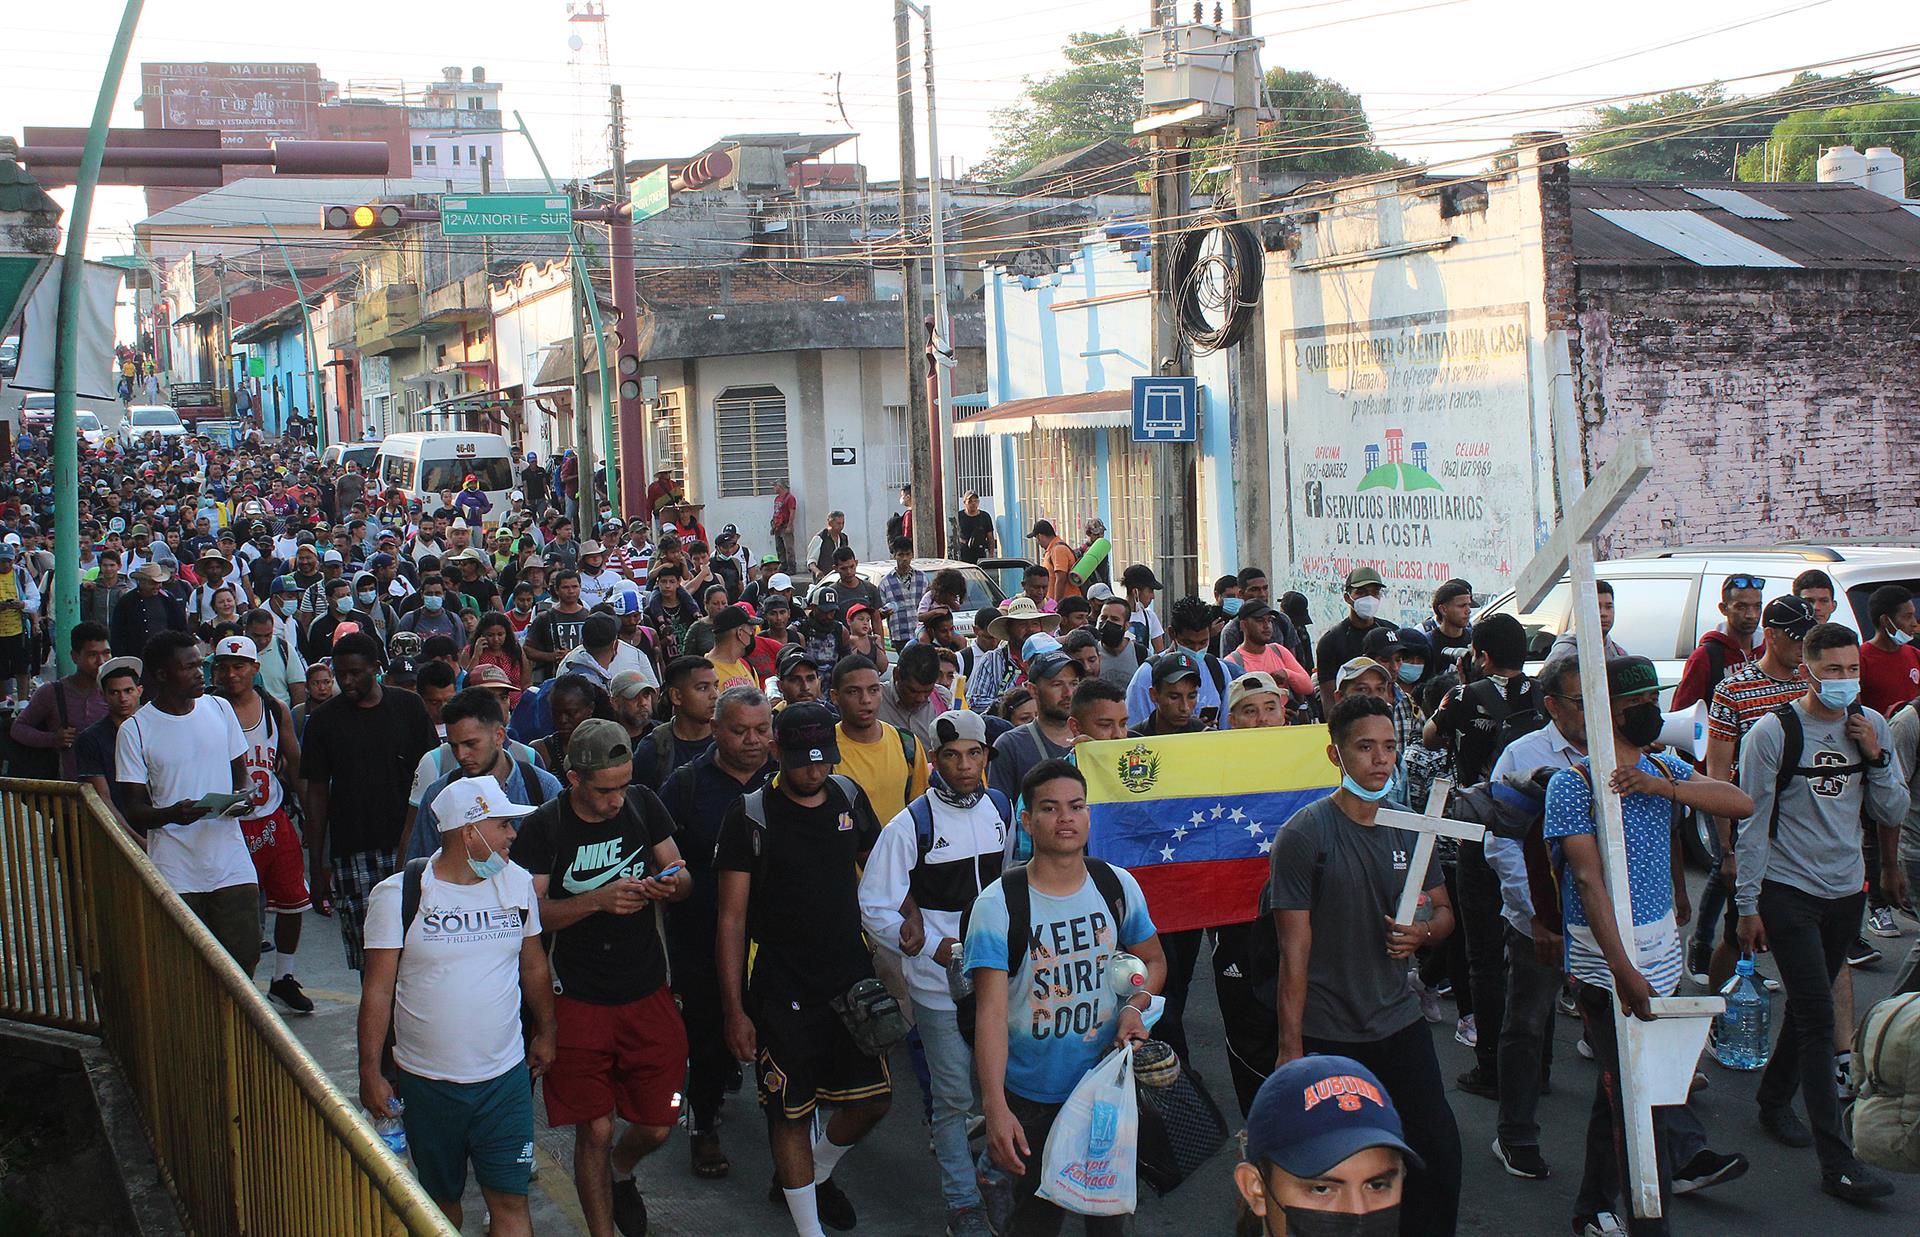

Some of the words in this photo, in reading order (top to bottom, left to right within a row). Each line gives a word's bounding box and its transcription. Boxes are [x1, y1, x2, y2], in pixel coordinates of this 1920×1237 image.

[159, 65, 208, 75] DIARIO
[229, 65, 305, 75] MATUTINO
[462, 213, 480, 225] AV.
[482, 213, 529, 225] NORTE
[540, 212, 569, 225] SUR
[1305, 342, 1348, 373] QUIERES
[1352, 338, 1395, 367] VENDER
[1408, 329, 1457, 360] RENTAR
[1462, 328, 1488, 356] UNA
[1491, 323, 1526, 353] CASA
[1315, 446, 1340, 460] OFICINA
[1455, 442, 1490, 457] CELULAR
[1325, 495, 1384, 519] SERVICIOS
[1389, 495, 1483, 520] INMOBILIARIOS
[1337, 522, 1351, 544] DE
[1357, 523, 1375, 546] LA
[1382, 523, 1432, 548] COSTA
[404, 660, 413, 672] LA
[573, 837, 623, 872] NIKE
[620, 861, 645, 880] SB
[423, 910, 501, 935] SOUL
[447, 931, 497, 944] FREEDOM
[1028, 911, 1108, 961] KEEP
[1033, 954, 1109, 1001] SURF
[1031, 998, 1104, 1040] COOL
